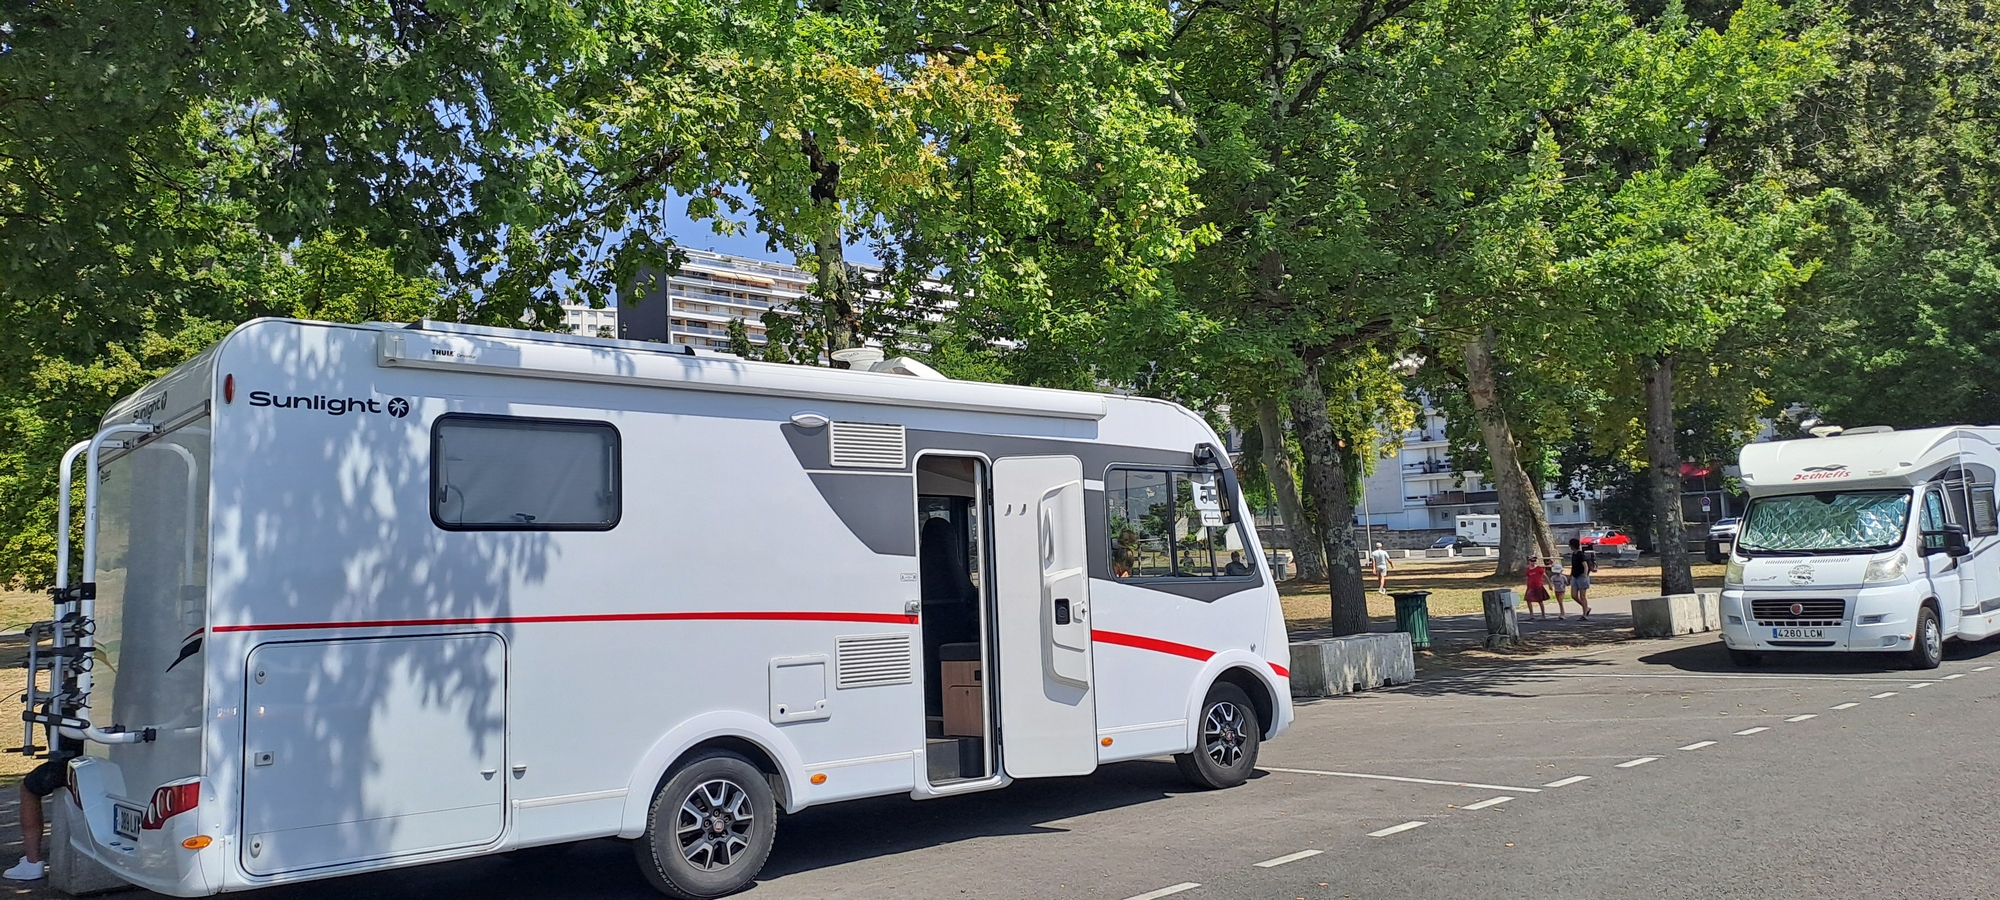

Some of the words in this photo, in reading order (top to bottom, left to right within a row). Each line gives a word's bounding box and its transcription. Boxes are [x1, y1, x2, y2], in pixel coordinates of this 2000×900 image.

[431, 349, 455, 357] THULE
[249, 391, 382, 416] Sunlight
[1778, 629, 1802, 638] 4280
[1804, 629, 1823, 638] LCM
